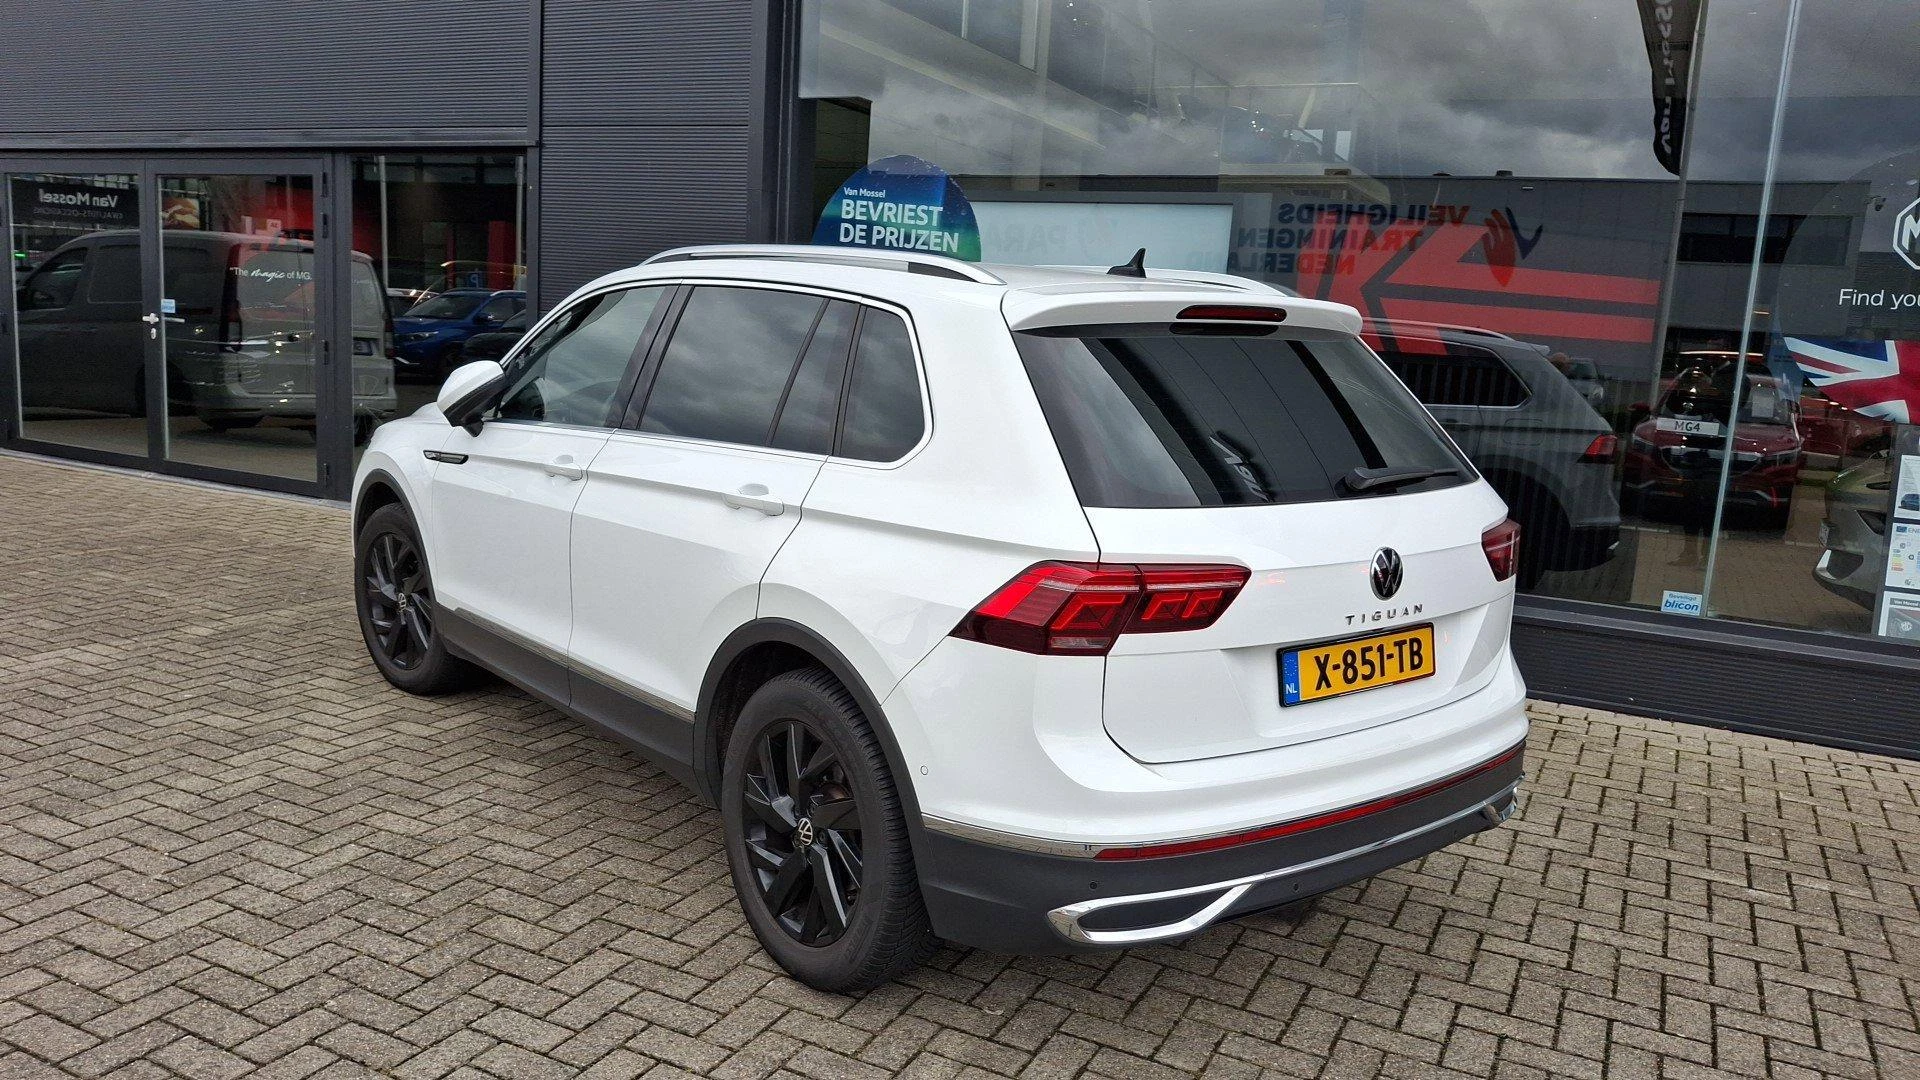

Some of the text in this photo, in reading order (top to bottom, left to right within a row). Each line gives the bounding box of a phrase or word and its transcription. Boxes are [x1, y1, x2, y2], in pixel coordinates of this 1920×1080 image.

[843, 186, 886, 199] Van Mossel
[841, 199, 943, 227] BEVRIEST
[839, 222, 959, 253] DE PRIJZEN
[287, 271, 295, 279] of
[1838, 288, 1885, 306] Find
[1674, 420, 1701, 432] MG4
[1664, 599, 1699, 611] blicon
[1345, 604, 1424, 626] TIGUAN
[1314, 637, 1424, 691] X-851-TB
[1286, 683, 1298, 694] NL
